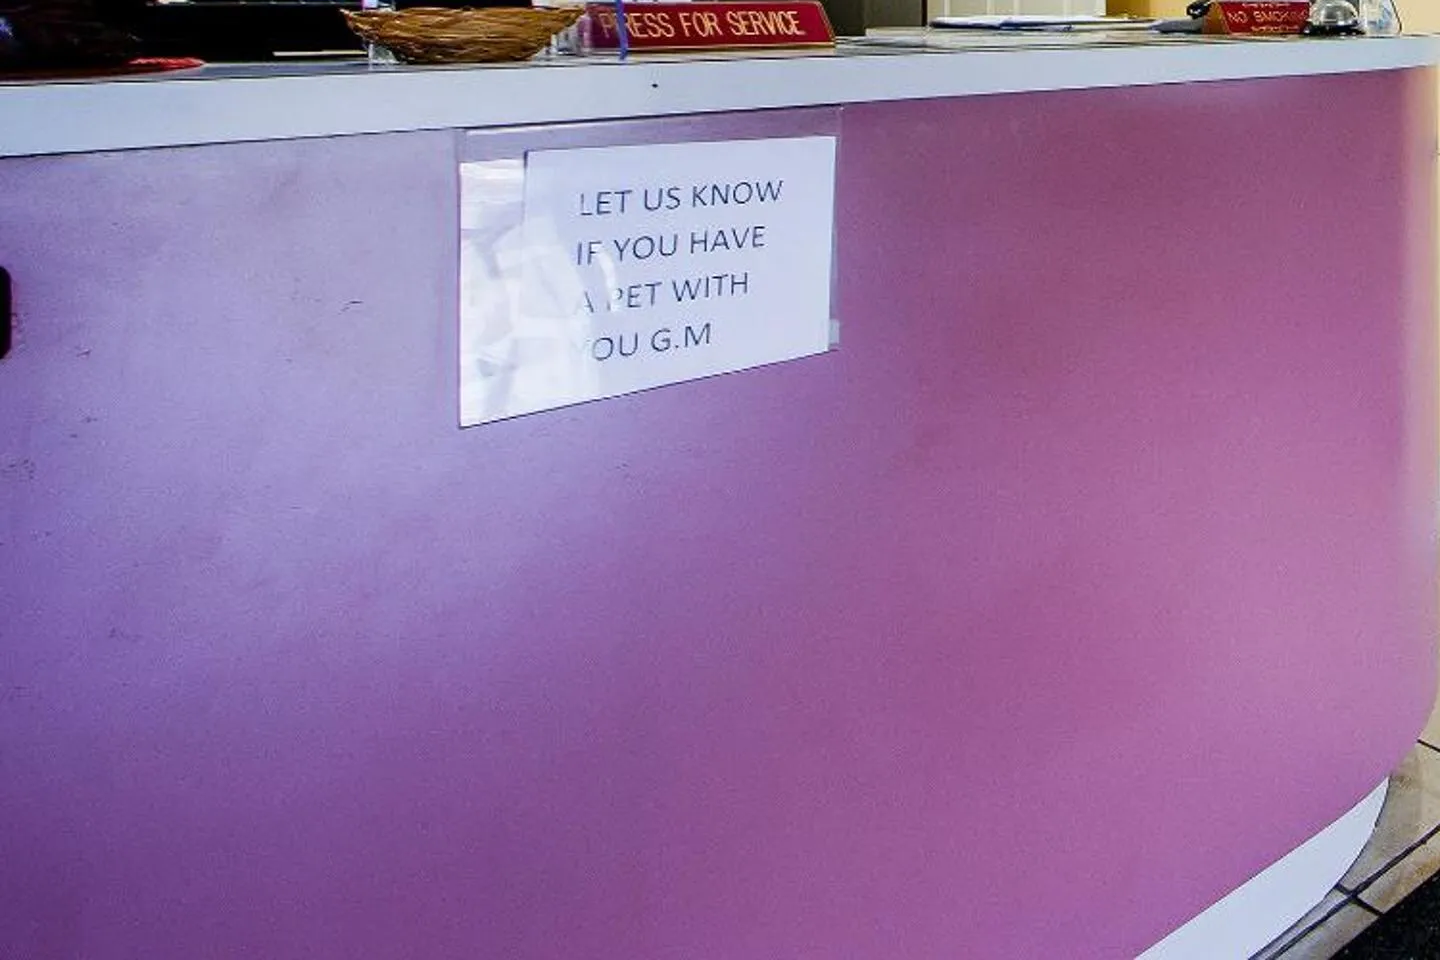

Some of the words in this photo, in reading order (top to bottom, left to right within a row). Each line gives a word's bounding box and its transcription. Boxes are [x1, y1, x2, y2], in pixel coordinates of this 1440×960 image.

[679, 11, 723, 38] FOR
[726, 10, 806, 37] SERVICE
[1227, 10, 1249, 24] NO
[579, 189, 633, 217] LET
[644, 186, 681, 211] US
[692, 179, 784, 208] KNOW
[577, 240, 602, 266] IF
[613, 233, 679, 262] YOU
[690, 225, 766, 255] HAVE
[606, 281, 663, 313] PET
[672, 271, 749, 303] WITH
[585, 332, 638, 362] OU
[650, 322, 712, 352] G.M
